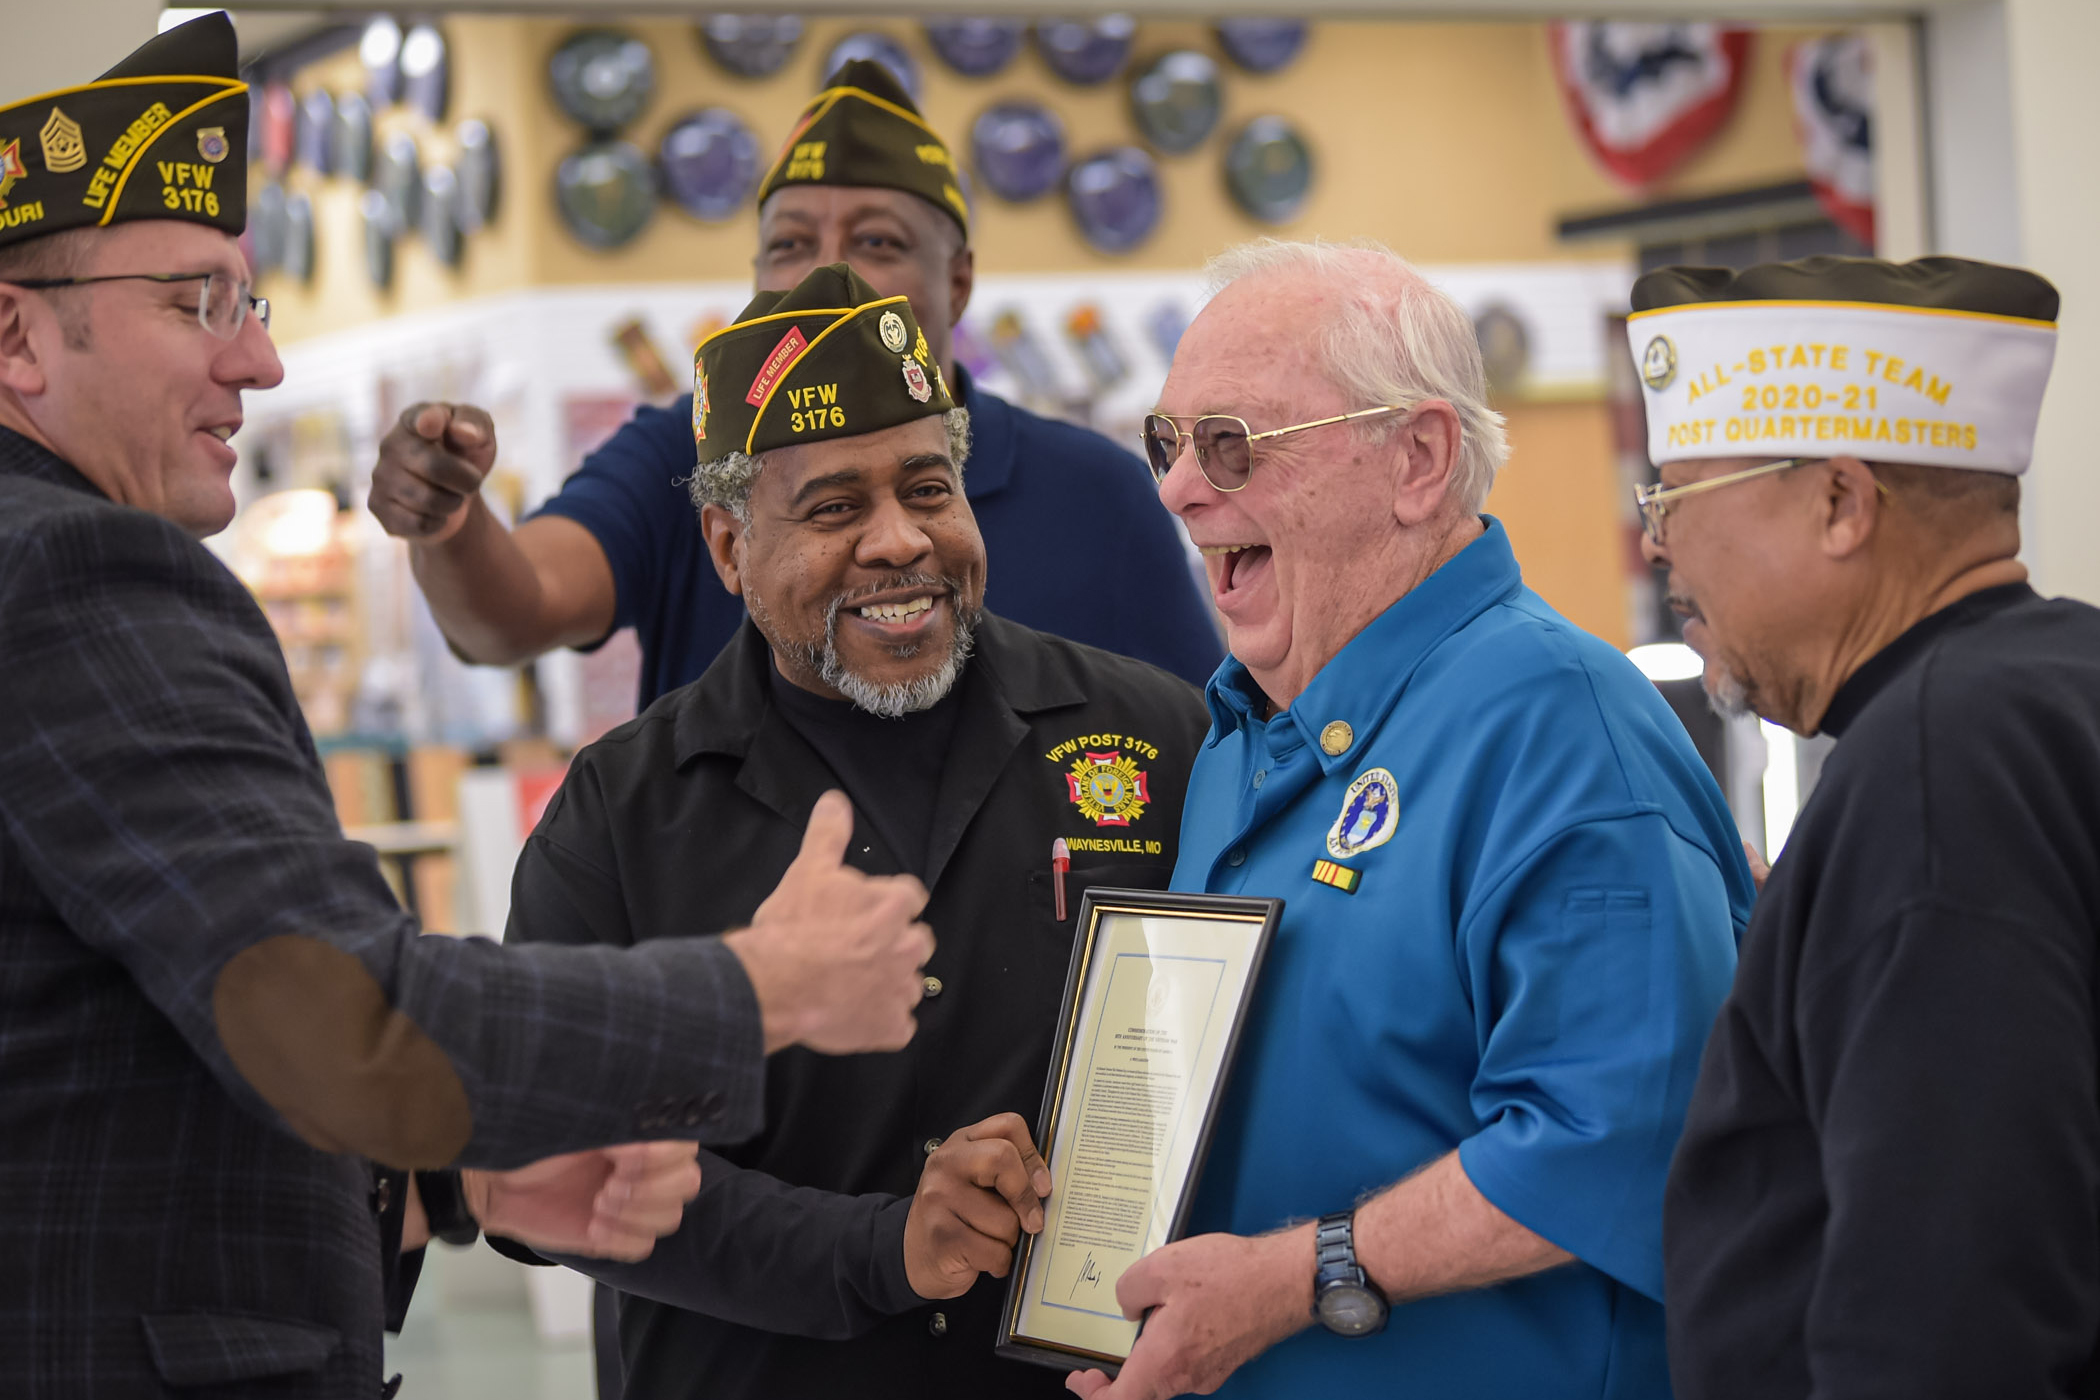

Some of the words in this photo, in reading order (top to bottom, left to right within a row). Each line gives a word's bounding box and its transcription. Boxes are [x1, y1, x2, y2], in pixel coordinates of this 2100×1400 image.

[82, 166, 118, 209] LIFE
[103, 101, 173, 171] MEMBER
[157, 161, 215, 190] VFW
[162, 186, 220, 217] 3176
[753, 377, 771, 401] LIFE
[766, 337, 799, 377] MEMBER
[1687, 343, 1850, 404] ALL-STATE
[1864, 350, 1953, 406] TEAM
[787, 383, 838, 410] VFW
[1742, 385, 1878, 411] 2020-21
[791, 406, 846, 433] 3176
[1667, 418, 1716, 447] POST
[1725, 416, 1978, 451] QUARTERMASTERS
[1045, 739, 1078, 763] VFW
[1077, 733, 1122, 749] POST
[1124, 737, 1159, 760] 3176
[1101, 765, 1133, 790] FOREIGN
[1066, 837, 1144, 854] WAYNESVILLE,
[1146, 840, 1161, 854] MO
